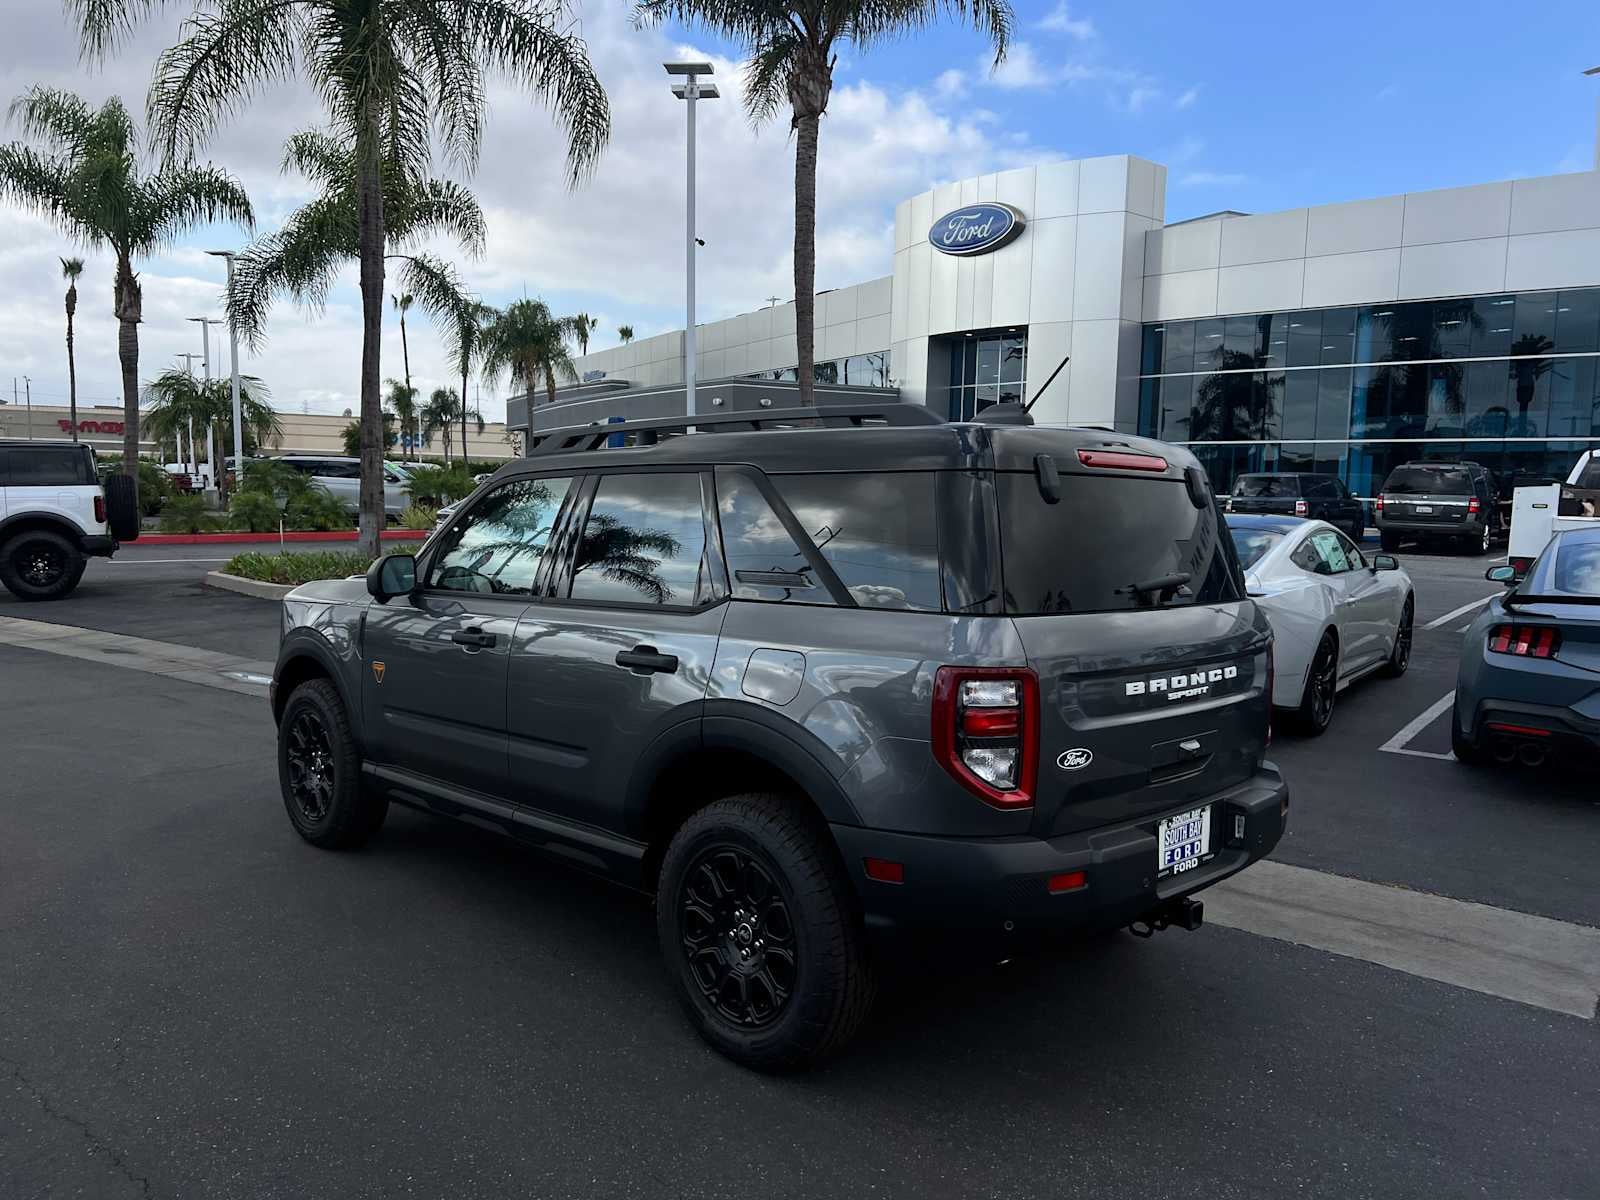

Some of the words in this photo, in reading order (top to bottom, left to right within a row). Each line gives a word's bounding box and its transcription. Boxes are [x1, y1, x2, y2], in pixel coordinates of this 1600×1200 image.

[943, 212, 994, 244] Ford
[1125, 666, 1238, 697] BRONCO
[1167, 686, 1209, 701] SPORT
[1063, 752, 1088, 767] Ford
[1165, 824, 1188, 846] SOUTH
[1189, 820, 1203, 839] BAY
[1165, 841, 1201, 864] FORD
[1173, 857, 1199, 875] FORD
